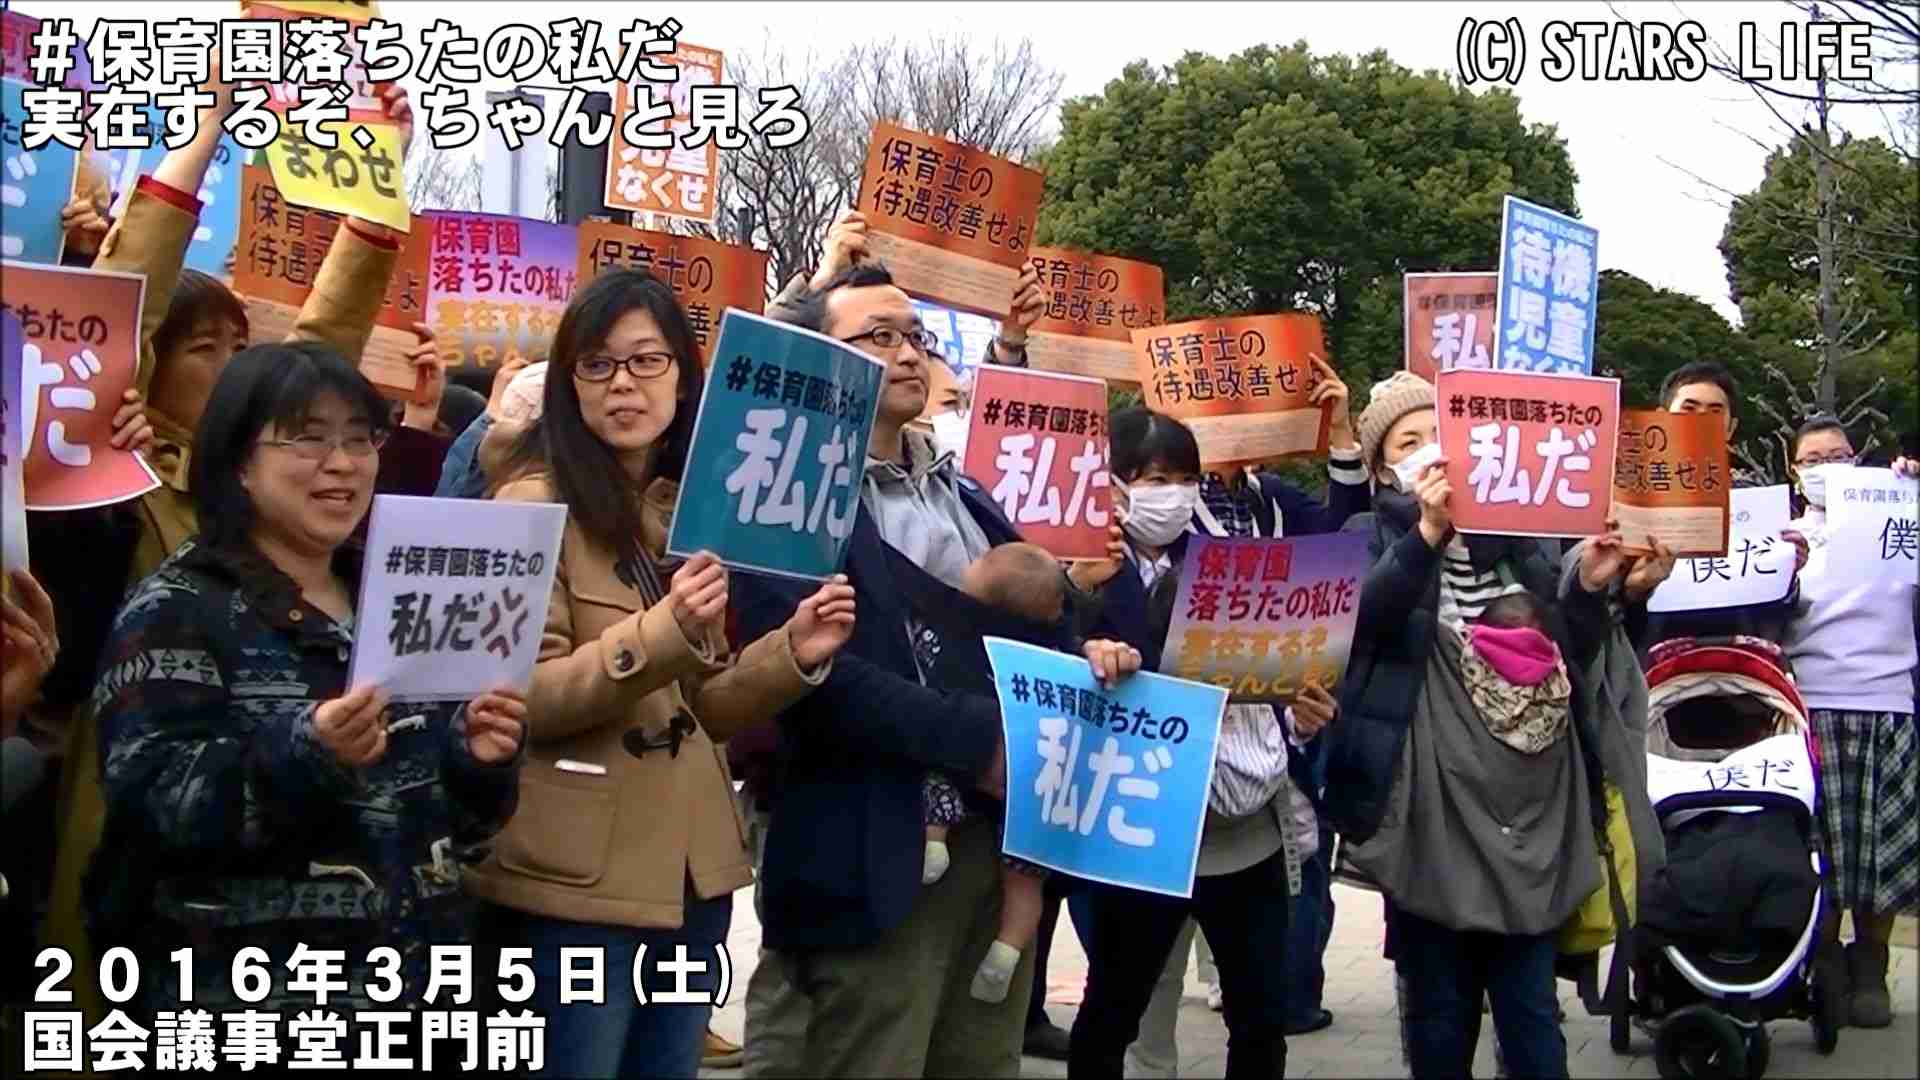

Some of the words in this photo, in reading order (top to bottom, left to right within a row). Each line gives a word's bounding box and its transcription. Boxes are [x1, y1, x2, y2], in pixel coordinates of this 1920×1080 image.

[616, 163, 708, 212] なくせ
[881, 136, 994, 198] 保育士の
[434, 217, 521, 257] 保育園
[872, 175, 1029, 254] 待遇改善せよ
[2, 302, 109, 346] ちたの
[1044, 290, 1160, 329] 遇改善せよ
[1146, 329, 1266, 369] 保育士の
[1431, 312, 1492, 370] 私
[983, 398, 1108, 437] #保育園落ち
[1449, 394, 1603, 427] #保育園落ちたの
[725, 407, 859, 539] 私だ
[991, 432, 1111, 528] 私だ
[1468, 422, 1598, 510] 私だ
[385, 545, 545, 577] #保育園落ちたの
[1198, 543, 1293, 582] 保育園
[388, 590, 485, 657] 私だ
[1187, 576, 1356, 622] 落ちたの私だ
[1011, 673, 1190, 745] #保育園落ちたの
[1034, 716, 1174, 848] 私だ
